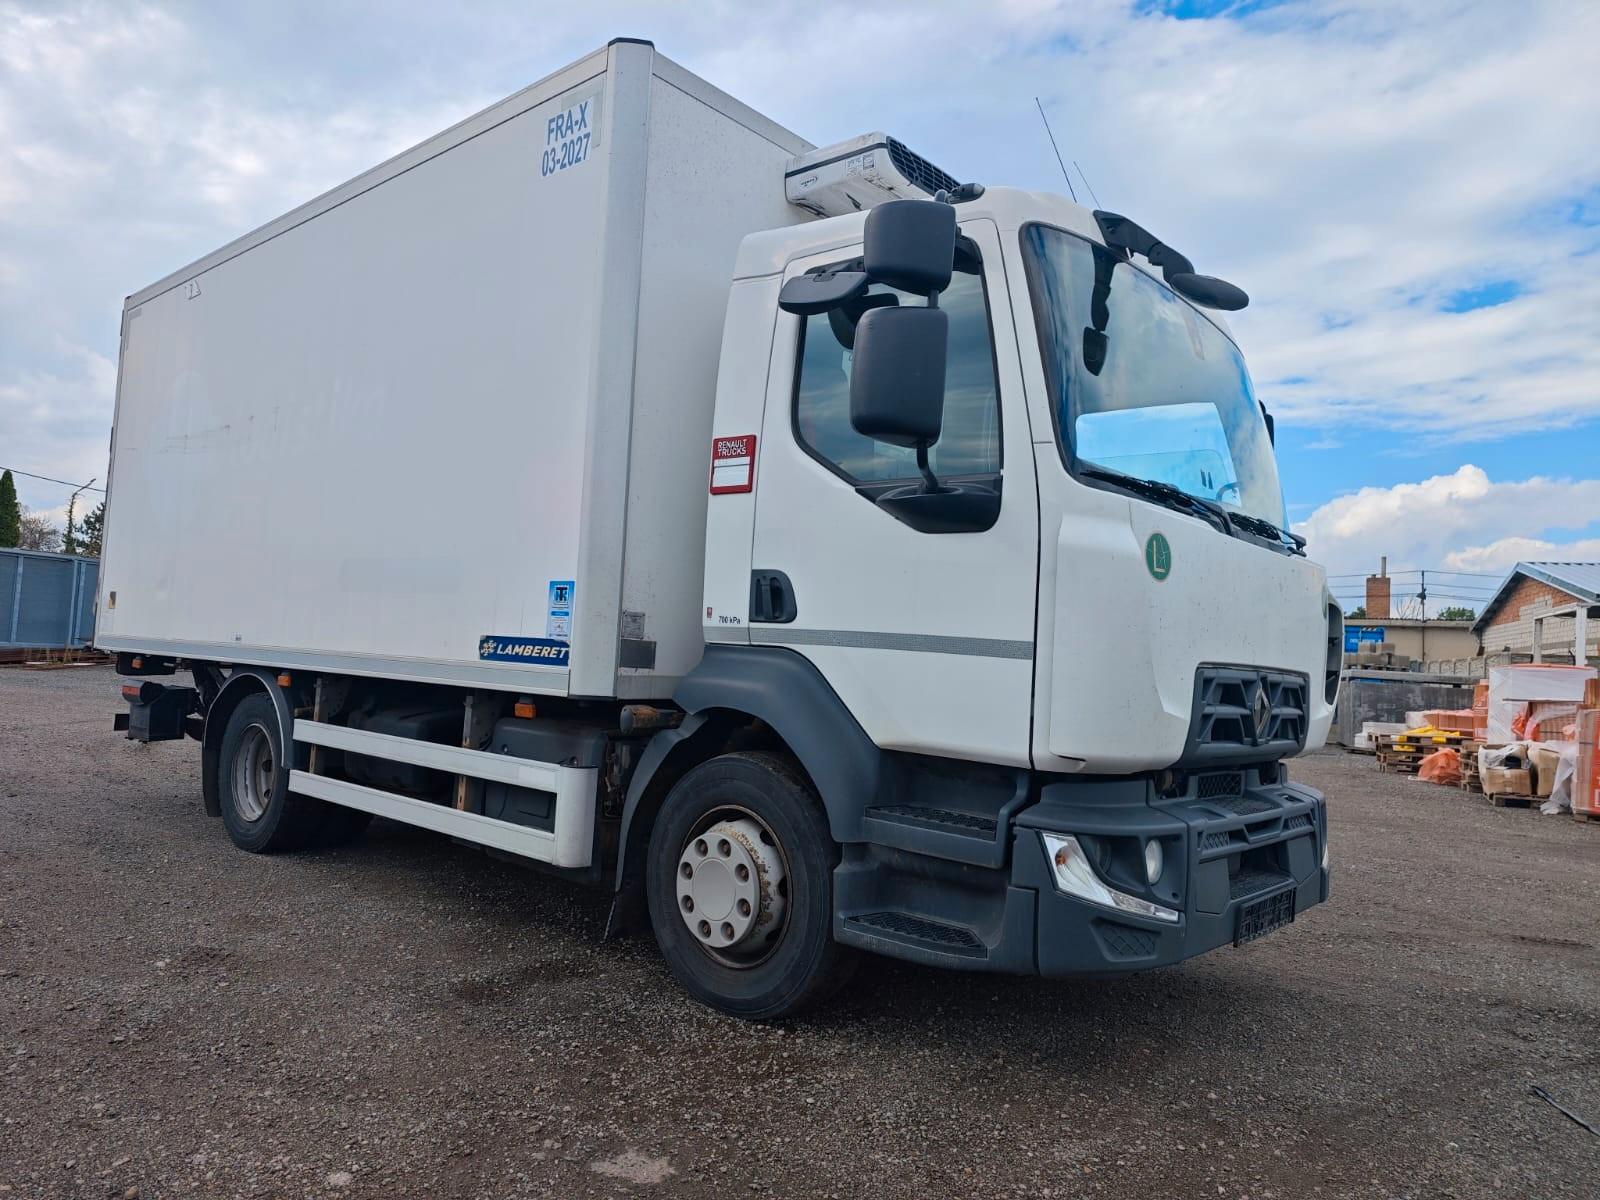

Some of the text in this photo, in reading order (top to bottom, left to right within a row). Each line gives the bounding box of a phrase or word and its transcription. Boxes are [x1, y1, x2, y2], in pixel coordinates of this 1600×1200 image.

[547, 101, 588, 145] FRA-X
[542, 132, 590, 176] 03-2027
[718, 439, 747, 449] RENAULT
[718, 447, 747, 456] TRUCKS
[1153, 540, 1166, 572] L
[729, 615, 741, 624] kPa
[496, 644, 569, 659] LAMBERET
